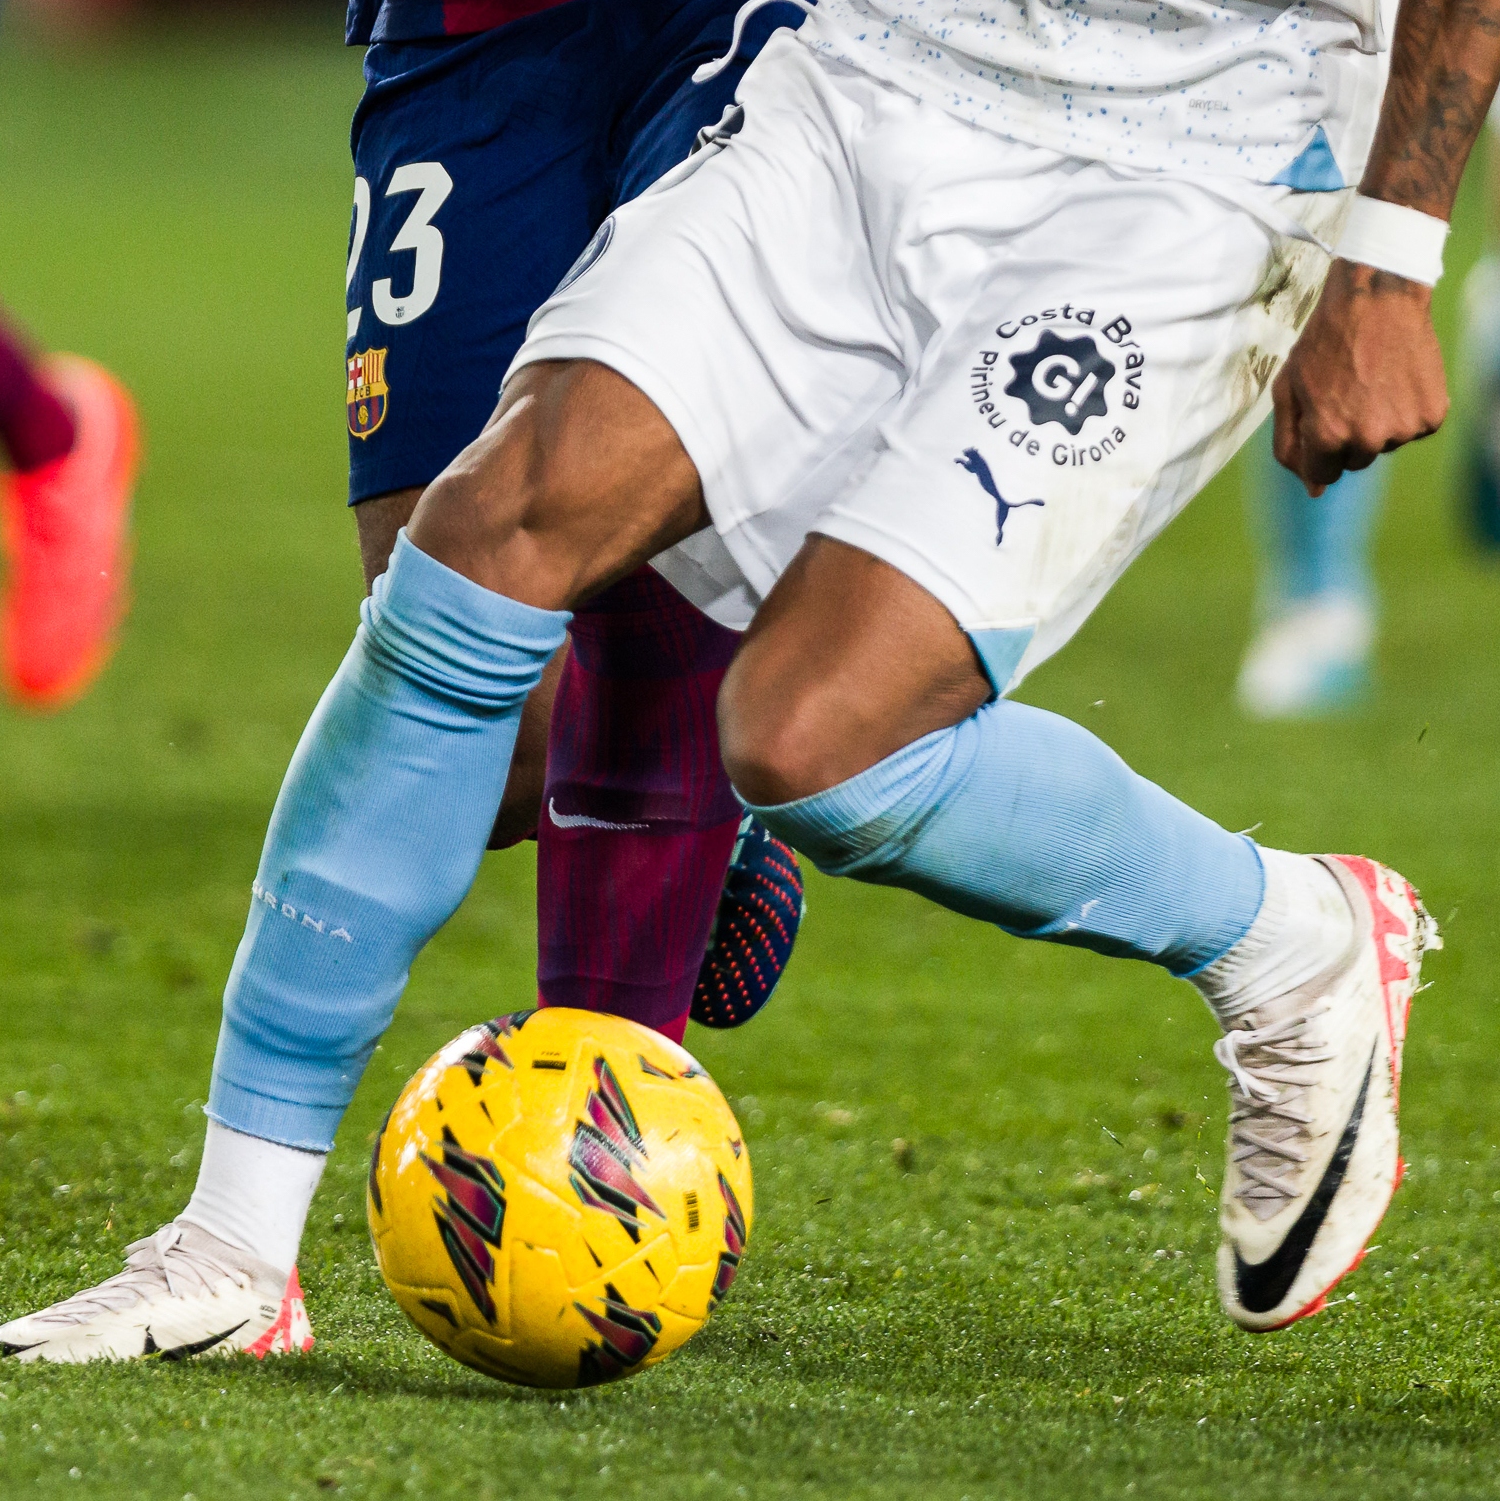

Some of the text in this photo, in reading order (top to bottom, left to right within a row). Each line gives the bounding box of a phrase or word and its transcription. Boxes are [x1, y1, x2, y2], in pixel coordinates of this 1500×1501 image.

[970, 350, 1127, 467] Pirineu de Girona
[995, 302, 1145, 410] Costa Brava
